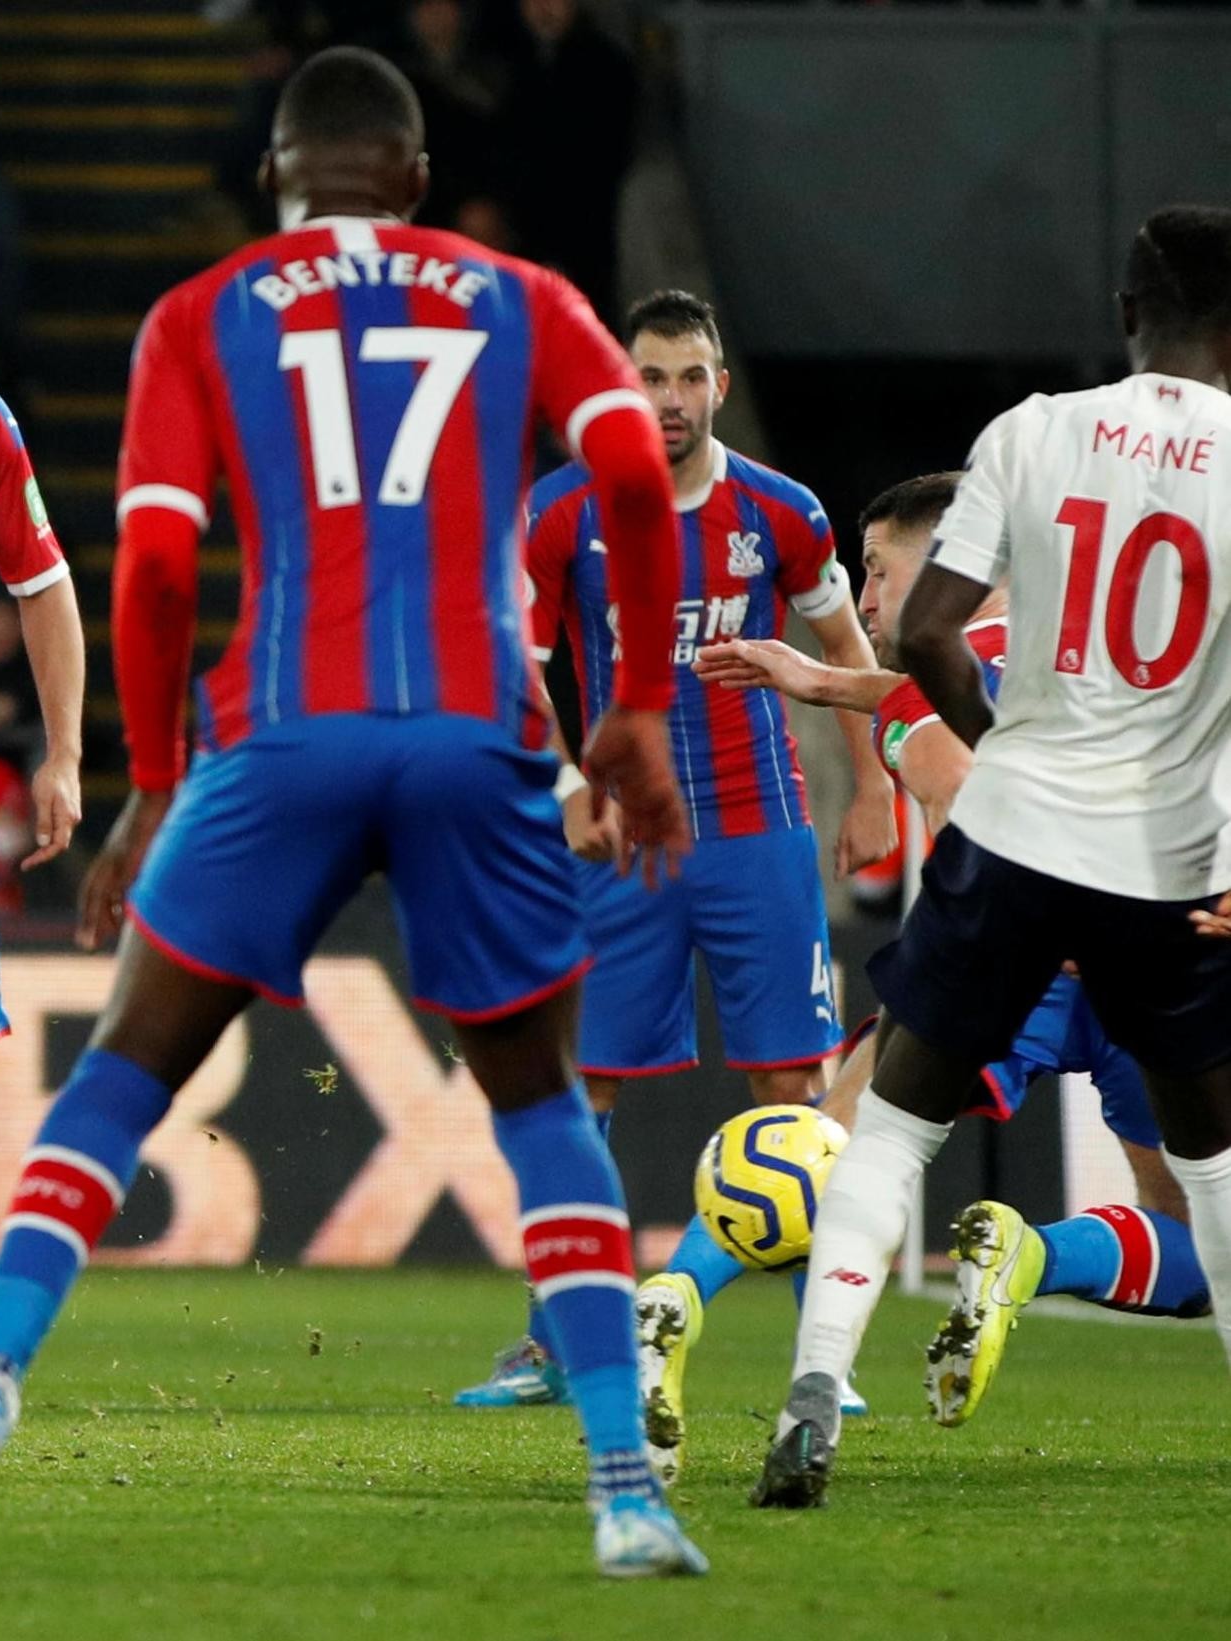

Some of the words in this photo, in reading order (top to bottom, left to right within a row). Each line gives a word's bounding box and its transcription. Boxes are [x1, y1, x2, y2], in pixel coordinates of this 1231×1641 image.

[251, 252, 490, 311] BENTEKE
[277, 325, 489, 510] 17
[1092, 419, 1216, 475] MANÉ
[1054, 496, 1212, 690] 10
